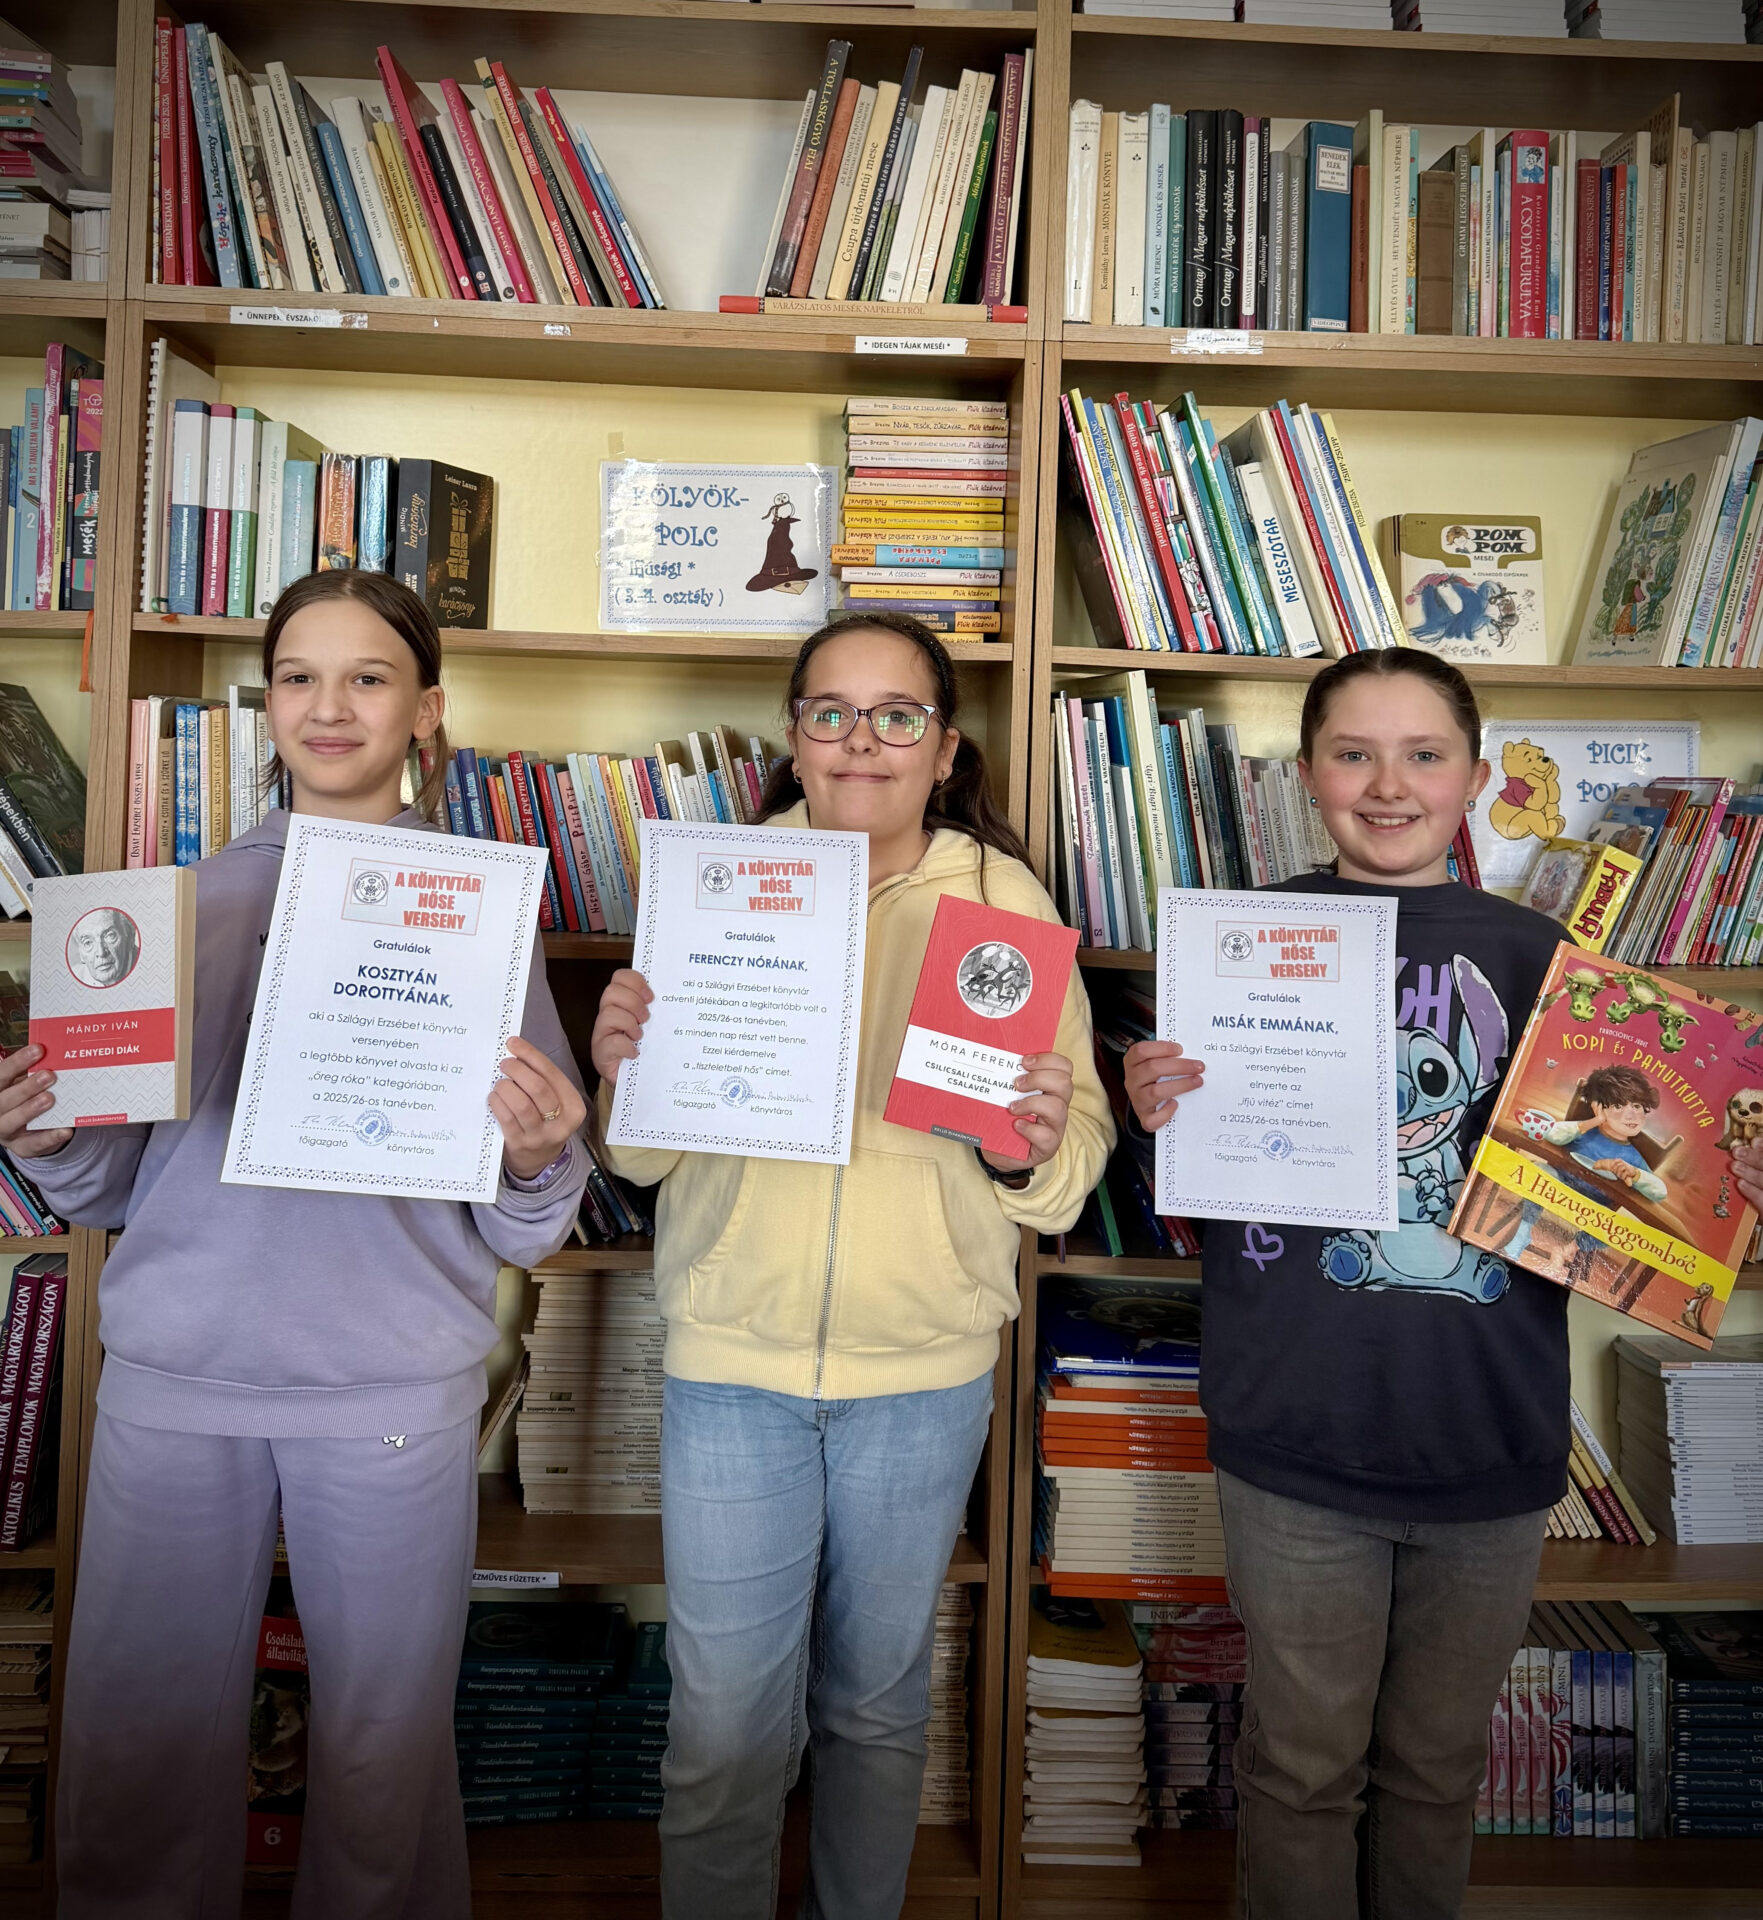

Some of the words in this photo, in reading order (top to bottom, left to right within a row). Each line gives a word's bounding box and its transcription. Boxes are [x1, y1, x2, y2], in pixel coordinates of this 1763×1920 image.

[830, 57, 838, 67] A
[1003, 66, 1018, 110] KÖNYVE
[810, 68, 838, 146] TOLLASKÍGYÓ
[1000, 111, 1014, 164] MESÉINEK
[804, 148, 817, 171] FIAI
[864, 142, 879, 170] mese
[850, 172, 874, 226] újdonatúj
[997, 166, 1010, 216] LEGSZEBB
[1194, 169, 1208, 222] népköltészet
[1521, 194, 1533, 206] A
[164, 187, 174, 258] GYERMEKDALOK
[590, 210, 614, 251] Karácsonya
[994, 220, 1006, 250] VILÁG
[841, 228, 862, 262] Csupa
[994, 250, 1002, 260] A
[1520, 207, 1533, 319] CSODAFURULYA
[772, 302, 831, 311] VARÁZSLATOS
[832, 304, 860, 312] MESÉK
[864, 304, 925, 314] NAPKELETRŐL
[86, 407, 104, 416] 2022
[80, 520, 97, 555] Mesék
[654, 522, 718, 547] POLC
[1470, 529, 1526, 541] POM
[1470, 542, 1527, 553] POM
[1262, 517, 1300, 603] MESESZÓTÁR
[663, 588, 713, 607] osztály
[511, 759, 532, 814] gyermekei
[524, 818, 537, 846] ambi
[737, 861, 746, 875] A
[748, 860, 813, 877] KÖNYVTÁR
[395, 872, 405, 887] A
[408, 871, 481, 893] KÖNYVTÁR
[760, 877, 792, 893] HŐSE
[418, 892, 456, 910] HŐSE
[748, 896, 803, 911] VERSENY
[1573, 859, 1632, 940] FABULA
[403, 910, 466, 930] VERSENY
[724, 930, 776, 943] Gratulálok
[1258, 930, 1267, 943] A
[1269, 926, 1337, 943] KÖNYVTÁR
[373, 939, 432, 955] Gratulálok
[1281, 946, 1315, 960] HŐSE
[689, 953, 745, 967] FERENCZY
[747, 953, 808, 972] NÓRÁNAK,
[1269, 964, 1328, 978] VERSENY
[357, 964, 437, 986] KOSZTYÁN
[333, 982, 453, 1009] DOROTTYÁNAK,
[682, 979, 695, 988] aki
[704, 981, 735, 992] Szilágyi
[736, 983, 771, 993] Erzsébet
[773, 985, 810, 996] könyvtár
[662, 995, 695, 1005] adventi
[695, 996, 740, 1008] játékában
[750, 1000, 801, 1012] legkitartóbb
[803, 1003, 819, 1012] volt
[1248, 992, 1301, 1004] Gratulálok
[308, 1010, 325, 1021] aki
[336, 1014, 375, 1026] Szilágyi
[377, 1017, 420, 1031] Erzsébet
[422, 1022, 468, 1036] könyvtár
[697, 1012, 742, 1024] 2025/26-os
[1212, 1014, 1256, 1029] MISÁK
[1260, 1016, 1339, 1035] EMMÁNAK,
[66, 1021, 107, 1035] MÁNDY
[112, 1020, 138, 1030] IVÁN
[351, 1035, 419, 1050] versenyében
[685, 1029, 718, 1038] minden
[720, 1032, 737, 1041] nap
[738, 1032, 757, 1041] részt
[759, 1034, 776, 1042] vett
[778, 1035, 808, 1045] benne.
[64, 1050, 77, 1059] AZ
[80, 1047, 114, 1058] ENYEDI
[116, 1044, 140, 1055] DIÁK
[702, 1046, 722, 1055] Ezzel
[724, 1047, 776, 1059] kiérdemelve
[930, 1039, 966, 1056] MÓRA
[1204, 1043, 1218, 1051] aki
[1229, 1043, 1263, 1054] Szilágyi
[1264, 1046, 1303, 1056] Erzsébet
[1306, 1048, 1347, 1058] könyvtár
[310, 1051, 353, 1064] legtöbb
[355, 1055, 398, 1069] könyvet
[400, 1060, 437, 1071] olvasta
[440, 1063, 449, 1072] ki
[925, 1061, 970, 1079] CSILICSALI
[1245, 1063, 1306, 1076] versenyében
[373, 1076, 447, 1093] kategóriában,
[947, 1077, 990, 1095] CSALAVÉR
[1250, 1081, 1288, 1091] elnyerte
[1563, 1032, 1604, 1053] KOPI
[1613, 1041, 1625, 1055] ÉS
[1632, 1049, 1715, 1128] PAMUTKUTYA
[323, 1092, 380, 1107] 2025/26-os
[382, 1096, 437, 1112] tanévben.
[673, 1099, 716, 1110] főigazgató
[750, 1105, 793, 1116] könyvtáros
[1286, 1100, 1313, 1110] címet
[1229, 1114, 1279, 1125] 2025/26-os
[1282, 1117, 1332, 1128] tanévben.
[299, 1135, 348, 1149] főigazgató
[387, 1142, 435, 1156] könyvtáros
[1214, 1152, 1258, 1164] főigazgató
[1292, 1158, 1336, 1168] könyvtáros
[1509, 1164, 1524, 1188] A
[1528, 1169, 1696, 1275] Hazugsággombóc
[27, 1282, 59, 1393] MAGYARORSZÁGON
[12, 1400, 38, 1475] TEMPLOMOK
[1, 1481, 24, 1545] KATOLIKUS
[510, 1574, 541, 1583] FÜZETEK
[266, 1646, 307, 1665] állatvilág
[264, 1827, 281, 1845] 6
